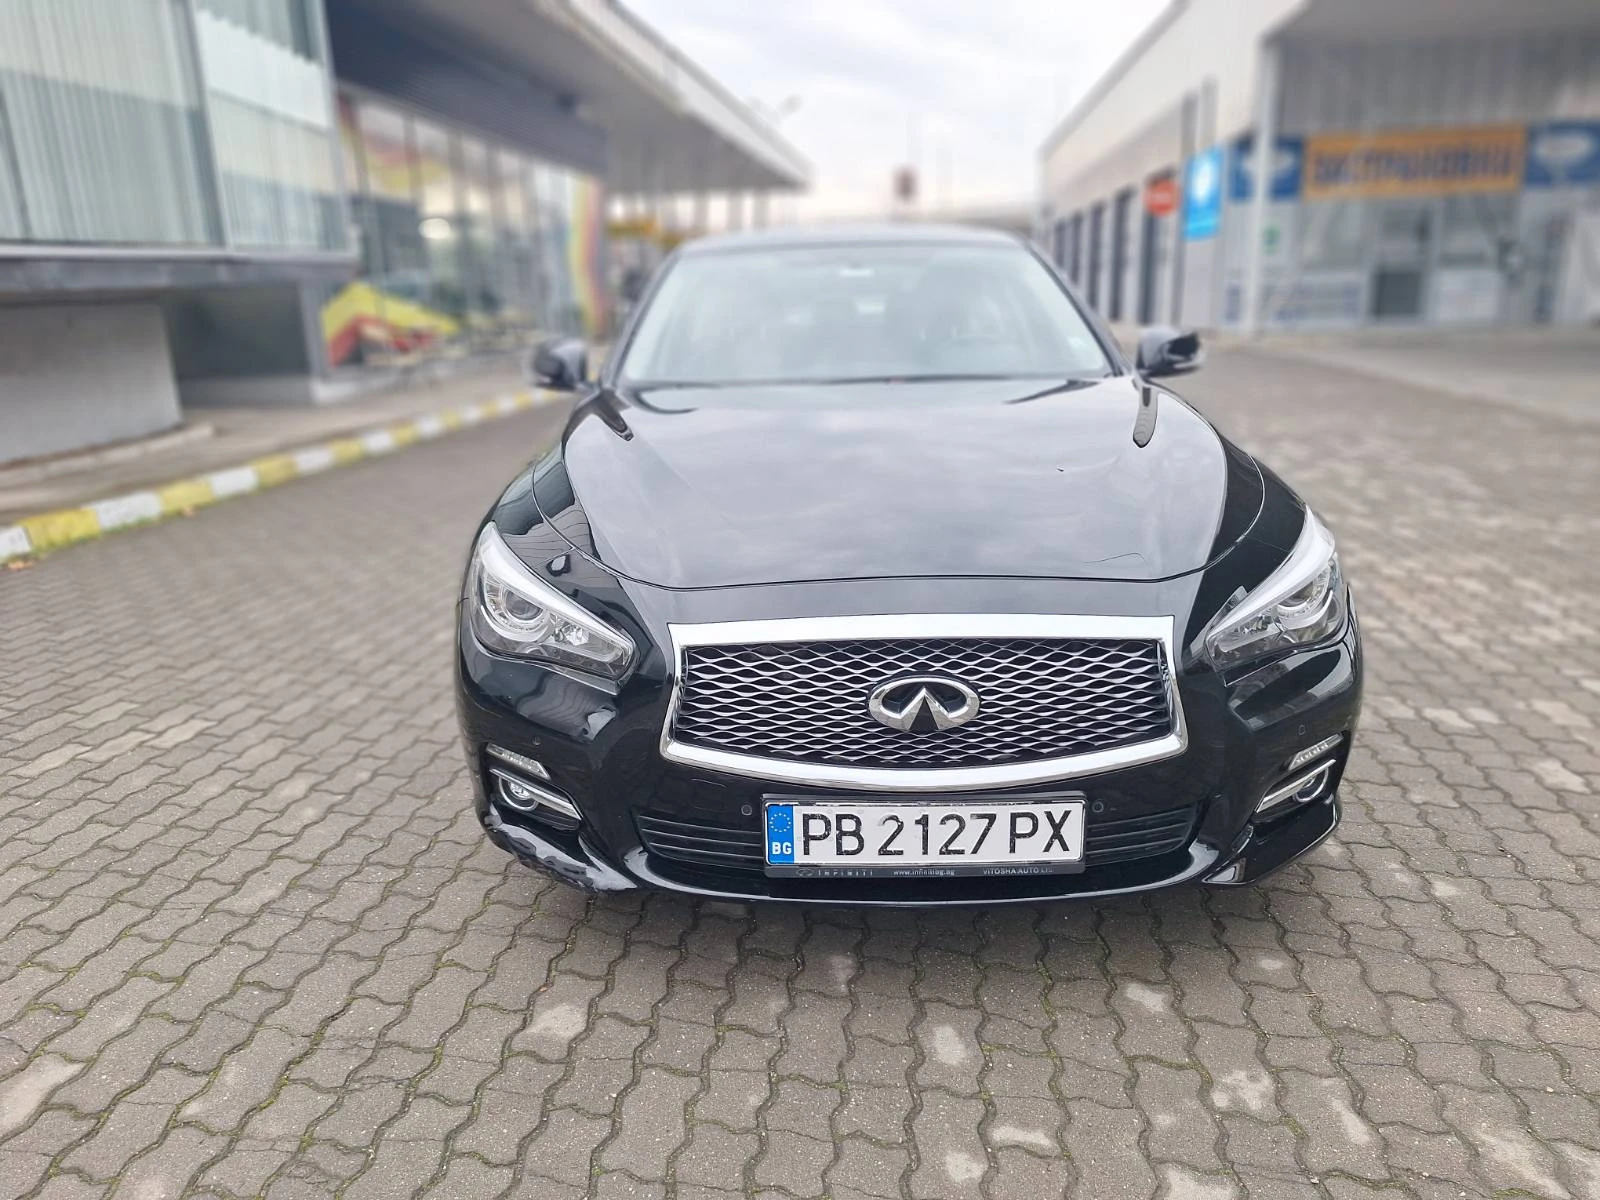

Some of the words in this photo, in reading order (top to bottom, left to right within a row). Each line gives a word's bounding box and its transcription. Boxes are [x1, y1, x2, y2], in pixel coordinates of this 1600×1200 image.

[803, 813, 865, 856] PB
[874, 813, 997, 856] 2127
[1008, 810, 1072, 854] PX
[771, 841, 792, 855] BG
[983, 867, 1016, 875] VITOSHA
[1017, 866, 1040, 874] AUTO
